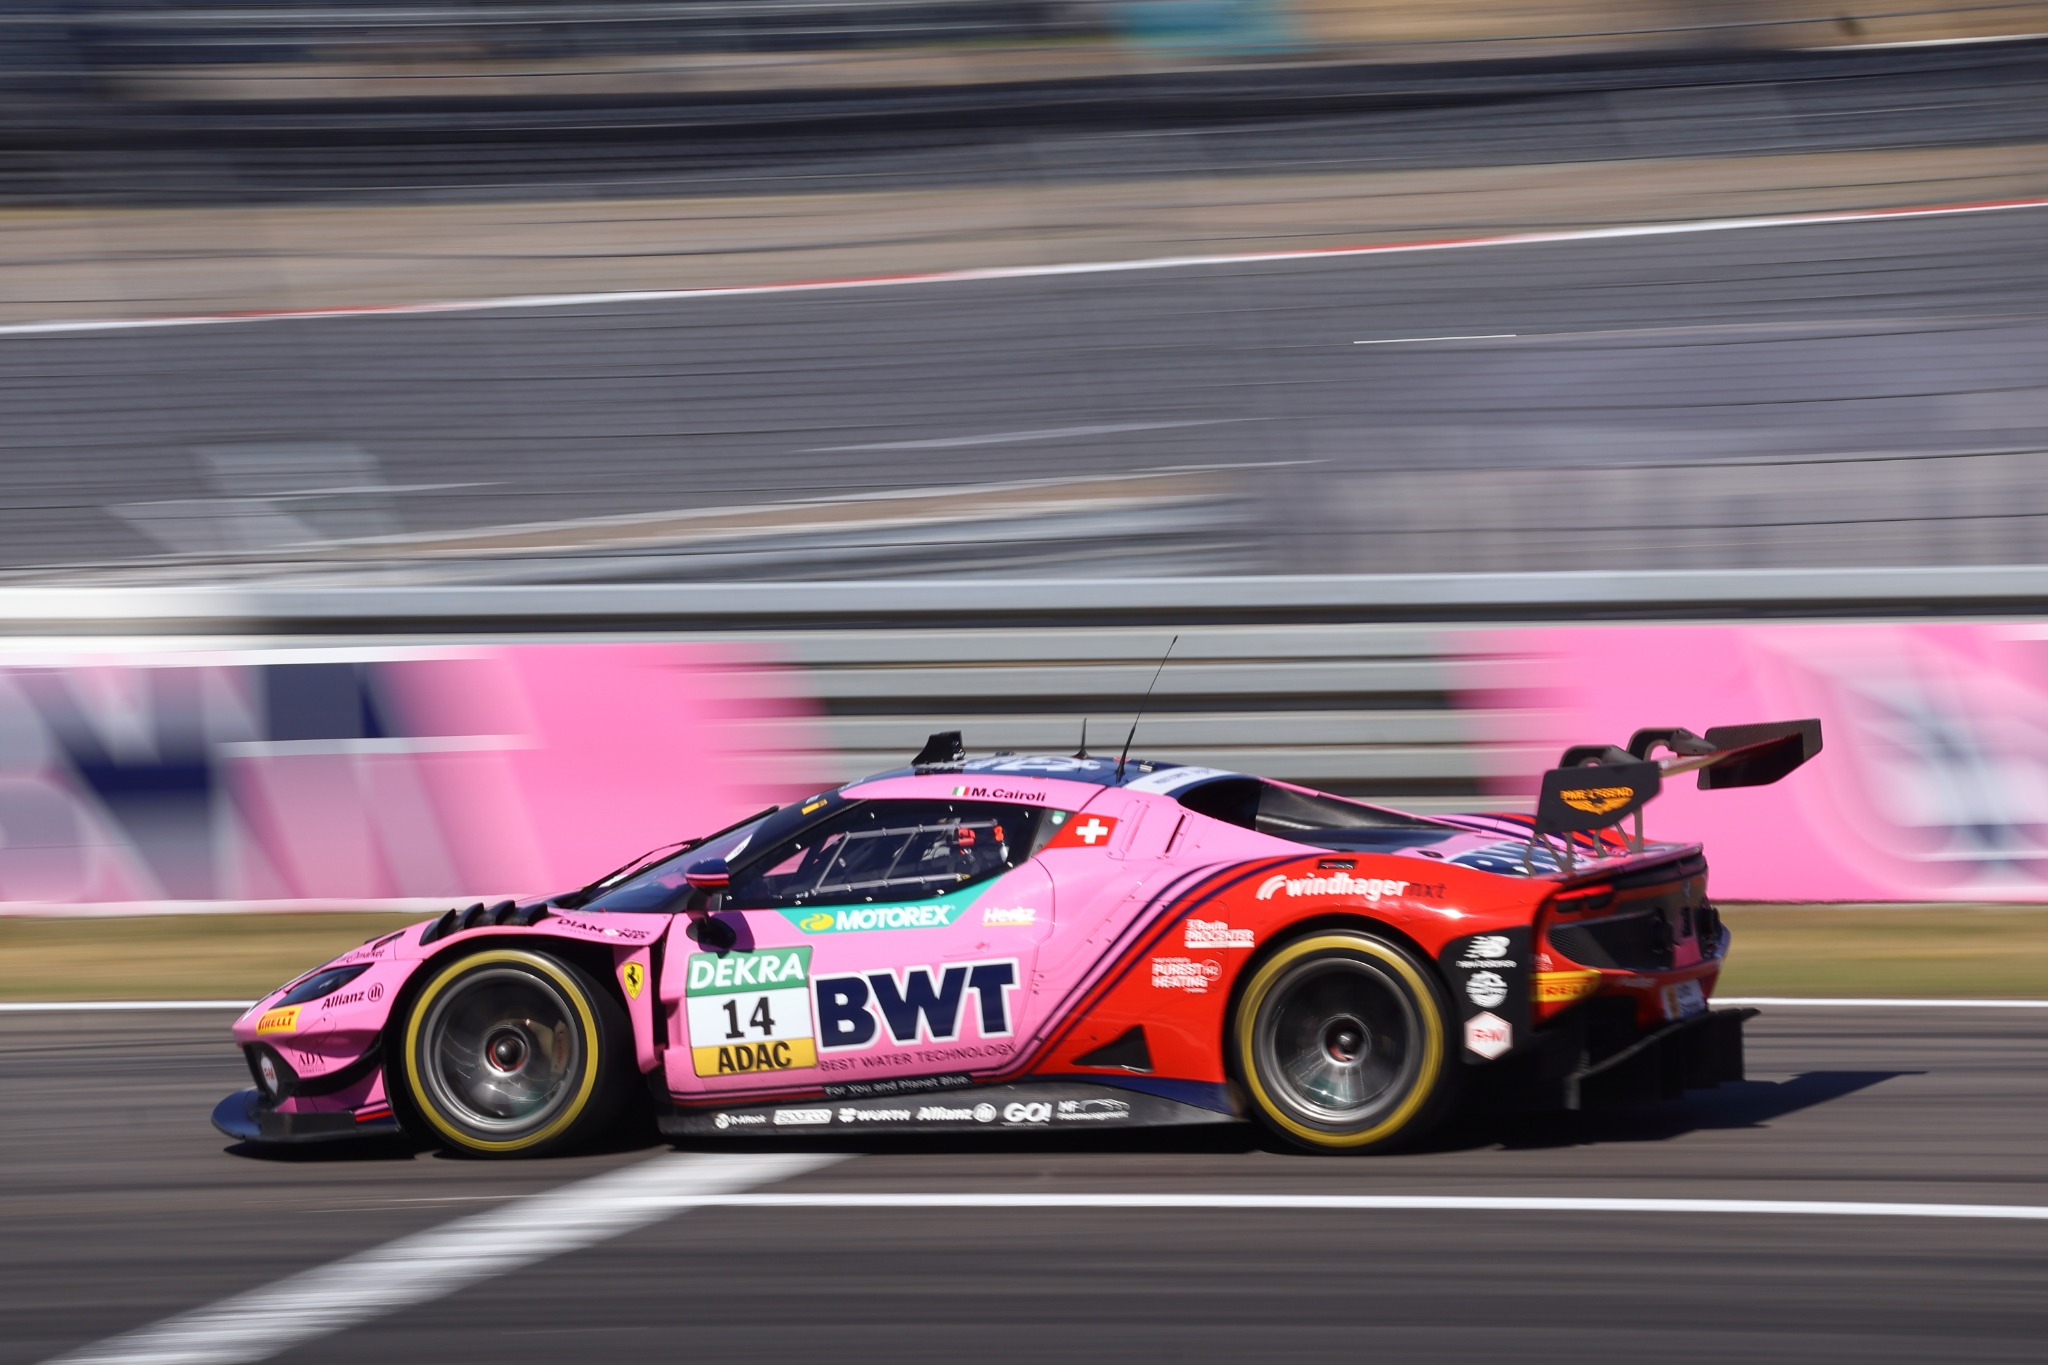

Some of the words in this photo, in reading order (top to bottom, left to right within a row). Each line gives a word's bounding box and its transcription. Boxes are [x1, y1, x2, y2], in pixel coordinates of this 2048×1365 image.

[1285, 872, 1410, 902] windhager
[836, 905, 951, 931] MOTOREX
[690, 953, 805, 990] DEKRA
[321, 991, 365, 1011] Allianz
[811, 957, 1021, 1053] BWT
[258, 1011, 295, 1031] PIRELLI
[723, 997, 776, 1039] 14
[718, 1041, 792, 1073] ADAC
[820, 1058, 857, 1072] BEST
[859, 1053, 913, 1068] WATER
[914, 1043, 1017, 1063] TECHNOLOGY
[1003, 1102, 1053, 1122] GO!
